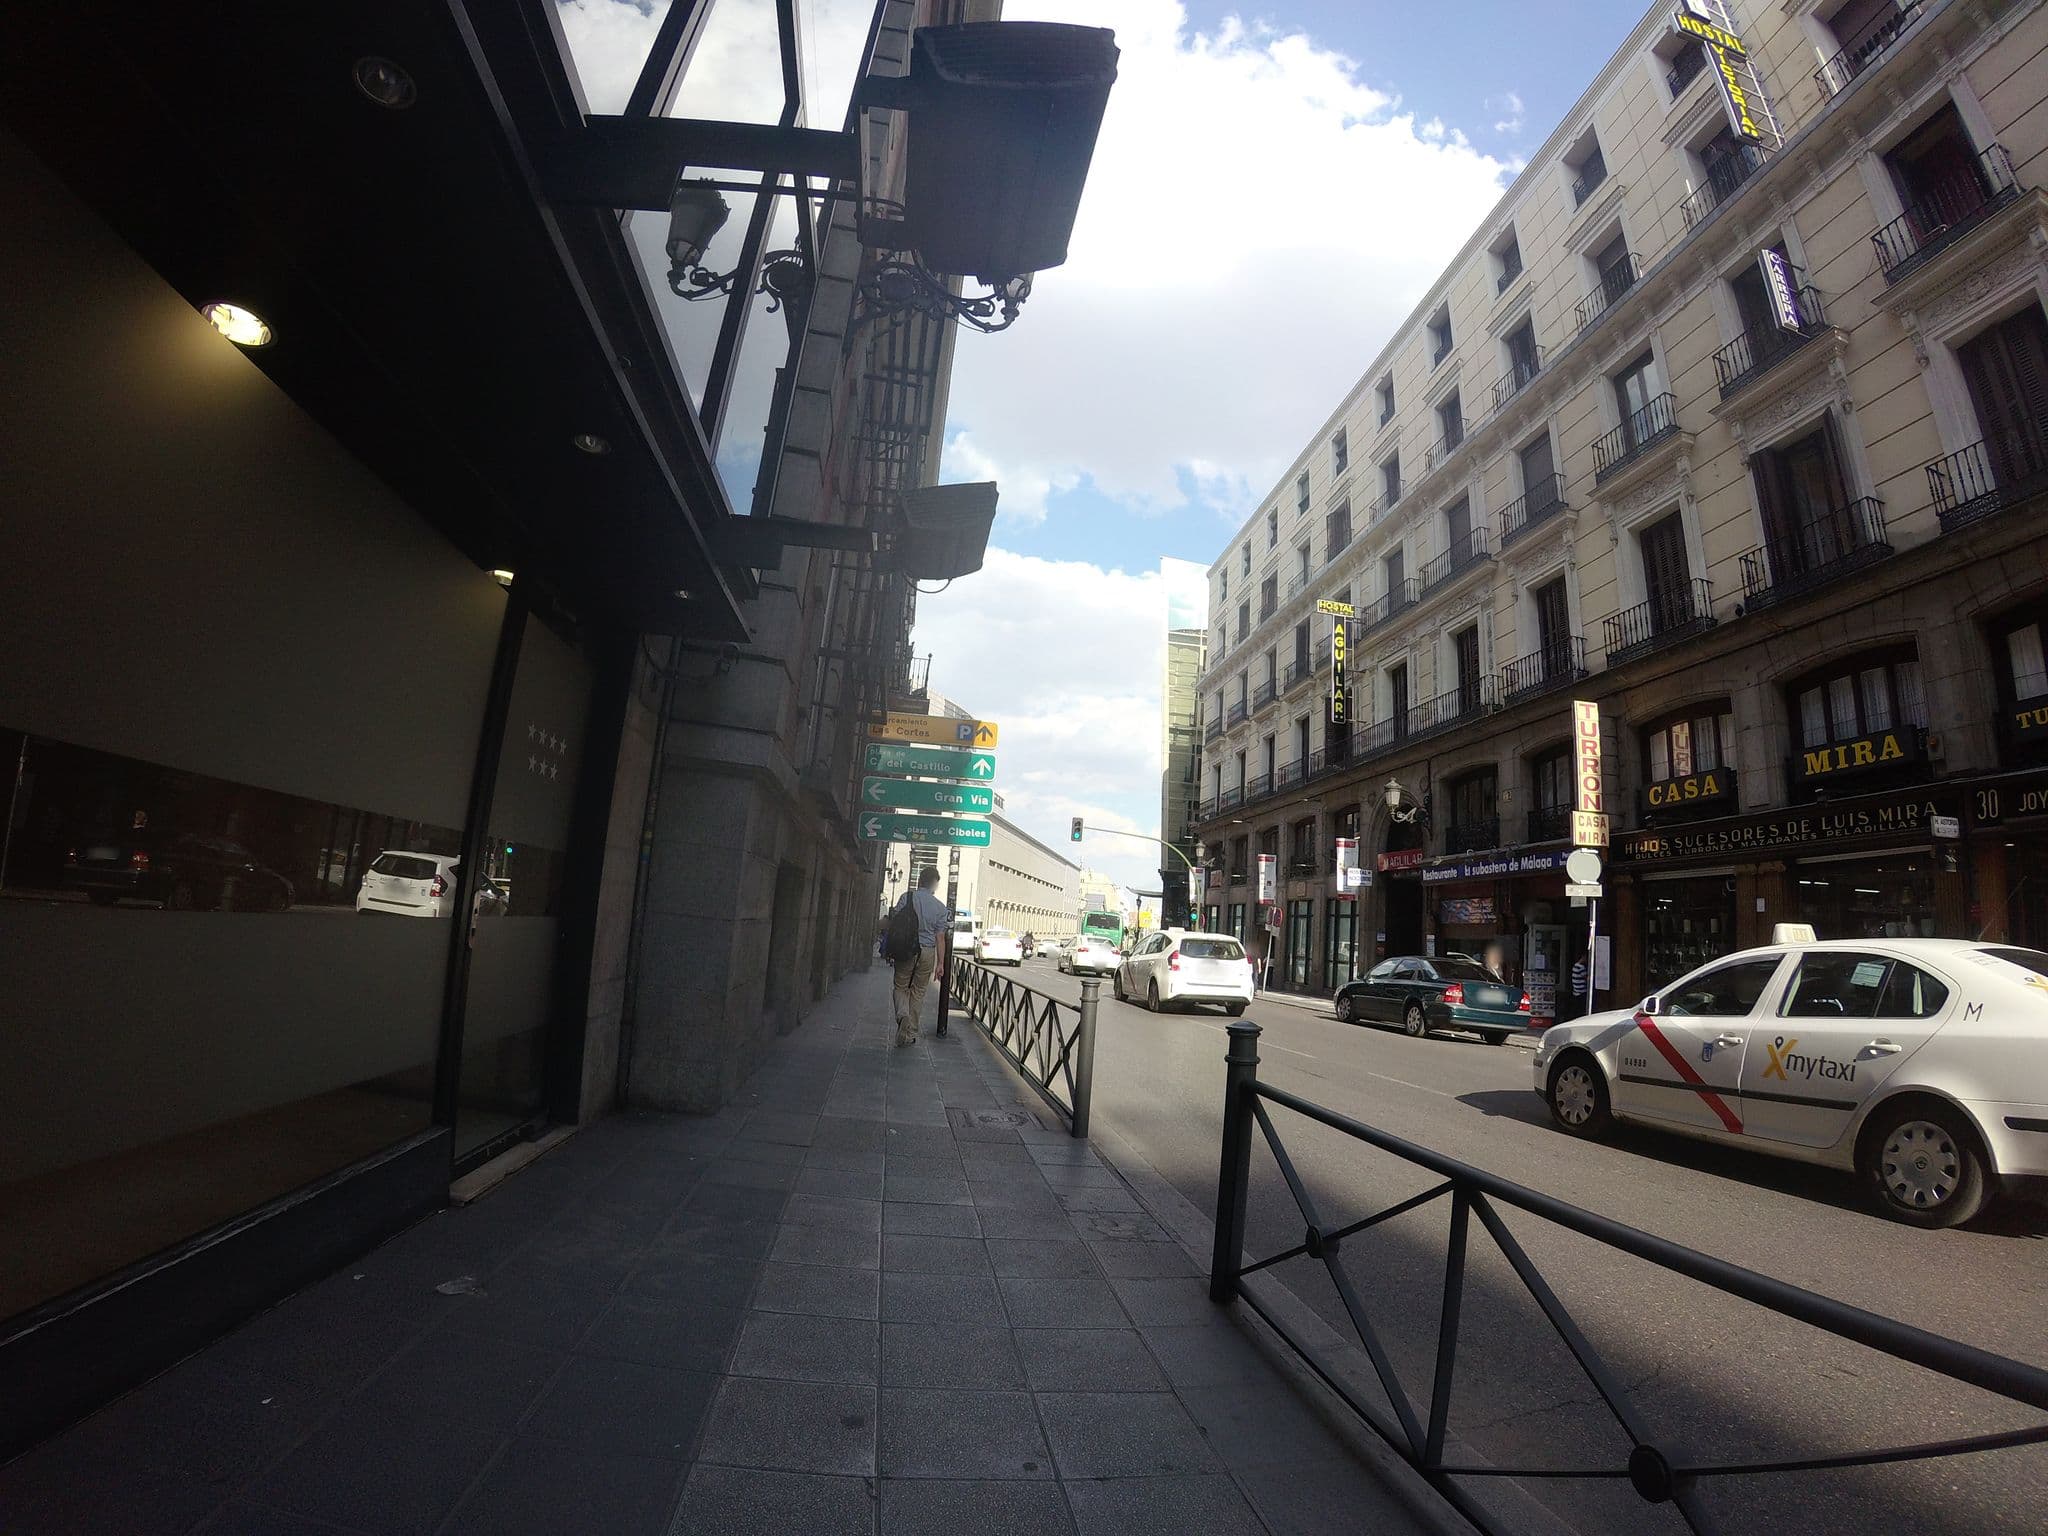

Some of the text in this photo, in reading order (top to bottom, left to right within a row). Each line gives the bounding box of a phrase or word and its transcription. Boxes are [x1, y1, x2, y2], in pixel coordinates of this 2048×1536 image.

[1677, 15, 1746, 54] HOSTAL
[1710, 43, 1757, 131] VICTORIA
[1769, 253, 1800, 328] CARRERA
[1319, 600, 1354, 613] HOSTAL
[1334, 623, 1345, 713] AGUILAR
[896, 727, 930, 737] Cortes
[886, 759, 903, 768] del
[910, 761, 951, 772] Castillo
[1578, 703, 1601, 812] TURRON
[1803, 734, 1904, 776] MIRA
[934, 792, 963, 804] Gran
[1649, 774, 1719, 806] CASA
[1976, 788, 1999, 820] 30
[947, 827, 987, 838] Cibeles
[1578, 814, 1607, 829] CASA
[1625, 801, 1939, 855] HIJOS SUCESORES DE LUIS MIRA
[1578, 832, 1607, 845] MIRA
[1635, 850, 1672, 860] DULCES
[1740, 832, 1817, 848] MAZAPANES
[1826, 819, 1918, 837] PELADILLAS
[1422, 869, 1458, 881] Restaurante
[1472, 862, 1507, 876] subastero
[1508, 857, 1519, 871] de
[1520, 855, 1553, 871] Málaga
[1963, 1001, 1984, 1022] M
[1786, 1053, 1857, 1082] mytaxi
